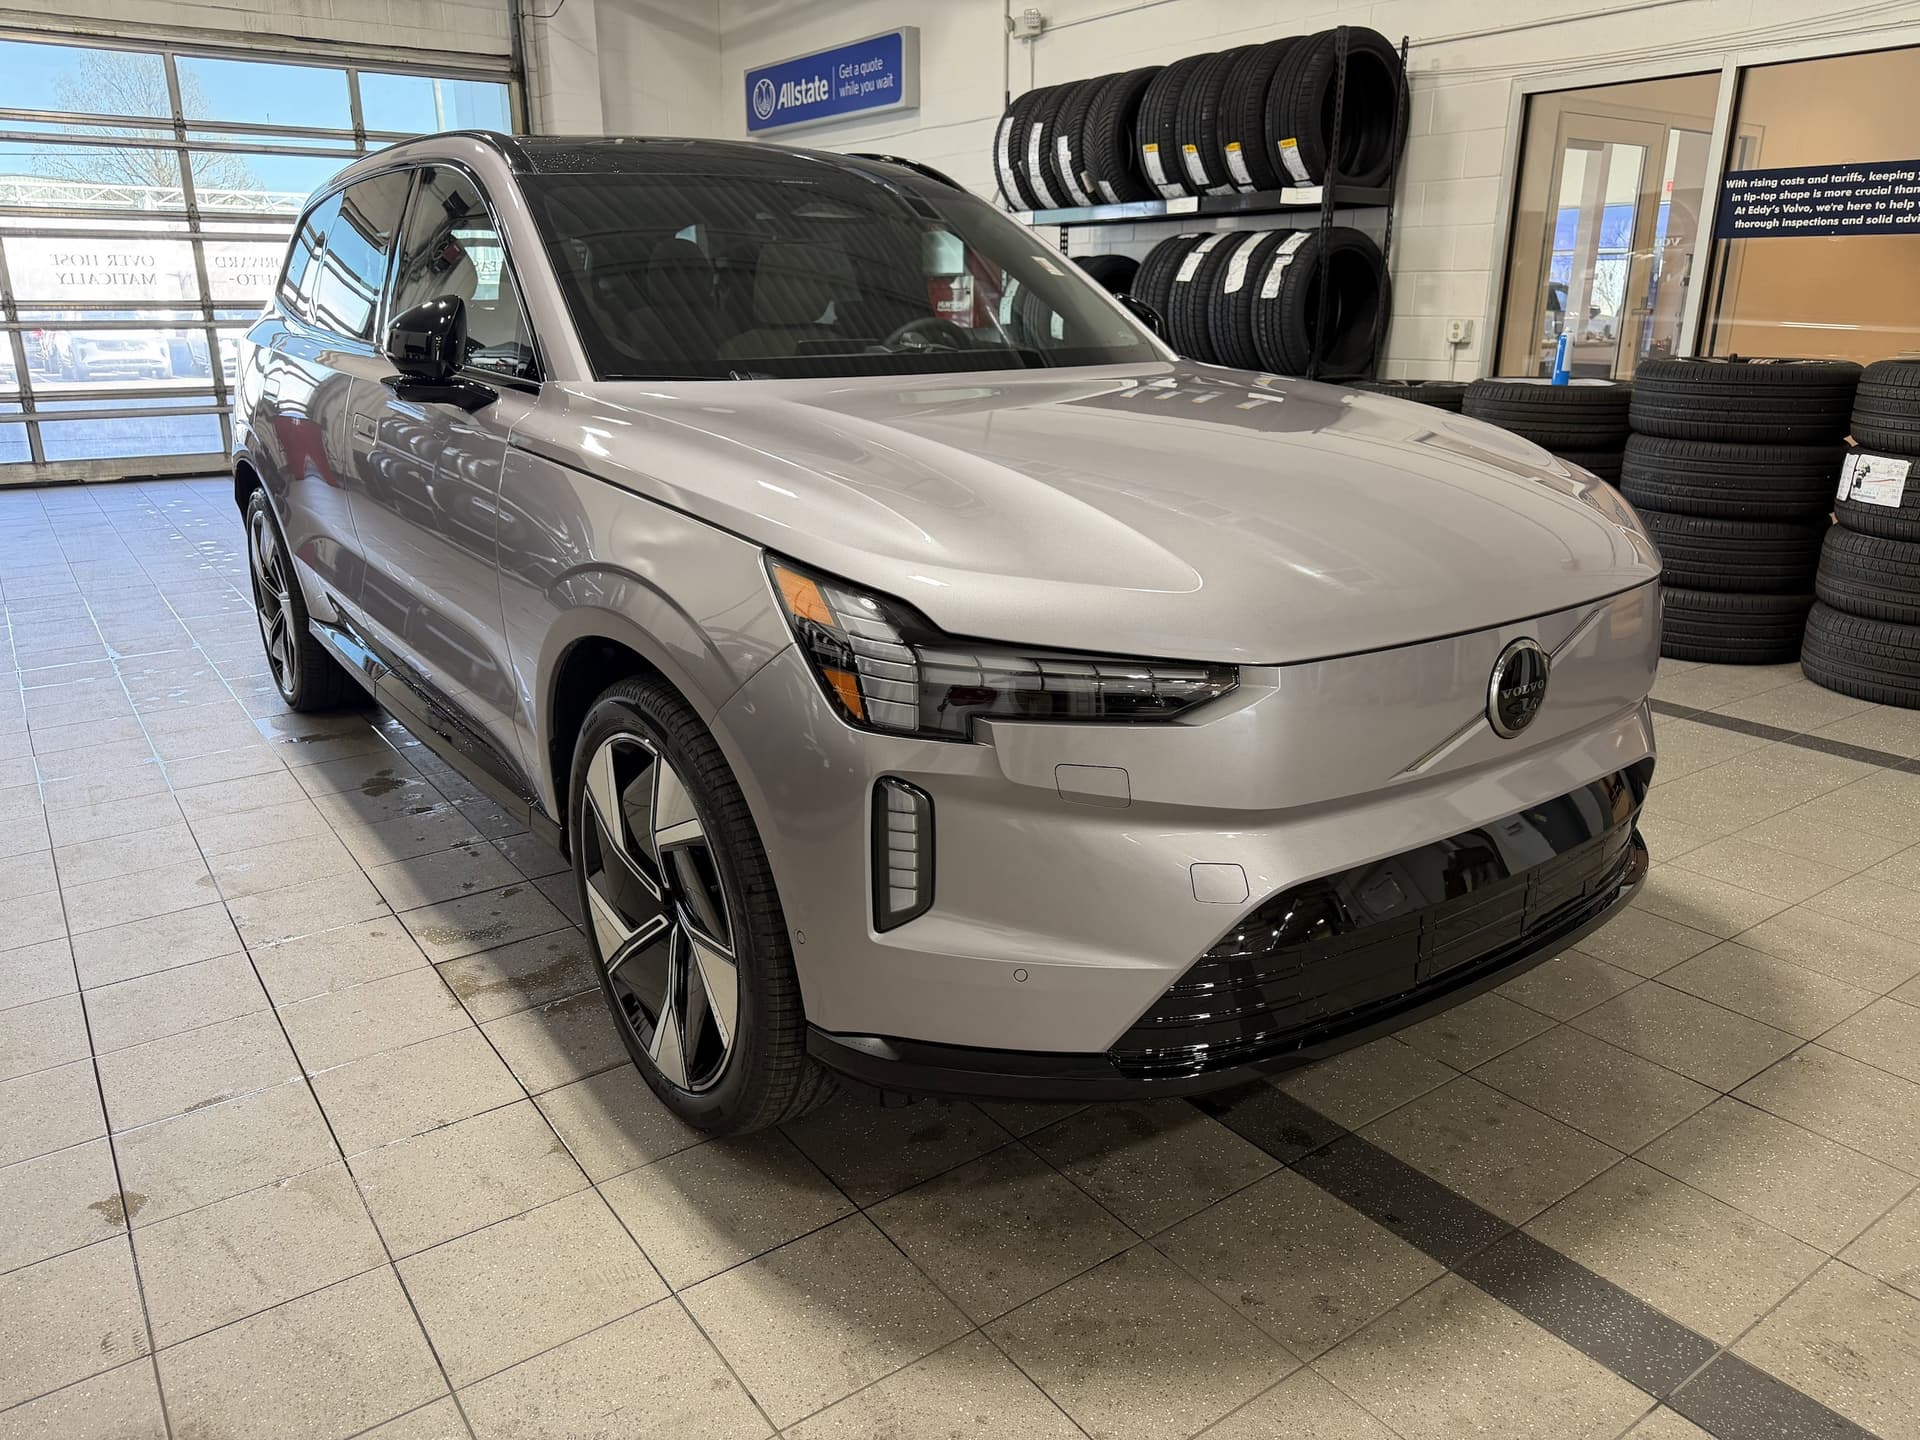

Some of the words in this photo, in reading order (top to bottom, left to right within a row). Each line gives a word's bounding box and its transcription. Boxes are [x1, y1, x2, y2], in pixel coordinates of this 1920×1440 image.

[839, 63, 853, 79] Get
[853, 65, 860, 75] a
[860, 57, 883, 76] quote
[777, 75, 829, 110] Allstate
[839, 81, 860, 97] while
[860, 82, 875, 97] you
[876, 73, 893, 90] wait
[1726, 179, 1748, 189] With
[1750, 178, 1778, 189] rising
[1780, 176, 1805, 186] costs
[1807, 174, 1828, 185] and
[1831, 172, 1865, 183] tariffs,
[1869, 170, 1915, 182] keeping
[1743, 190, 1777, 203] tip-top
[1779, 189, 1810, 202] shape
[1813, 187, 1822, 198] is
[1824, 188, 1852, 198] more
[1855, 185, 1892, 196] crucial
[1894, 184, 1920, 195] than
[1734, 206, 1746, 215] At
[1748, 204, 1780, 217] Eddy's
[1782, 203, 1813, 214] Volvo,
[1816, 202, 1844, 212] we're
[1846, 200, 1873, 211] here
[1875, 200, 1887, 210] to
[1889, 198, 1915, 211] help
[1734, 216, 1779, 230] thorough
[1841, 214, 1863, 225] and
[1866, 213, 1893, 224] solid
[1501, 680, 1544, 699] VOLVO
